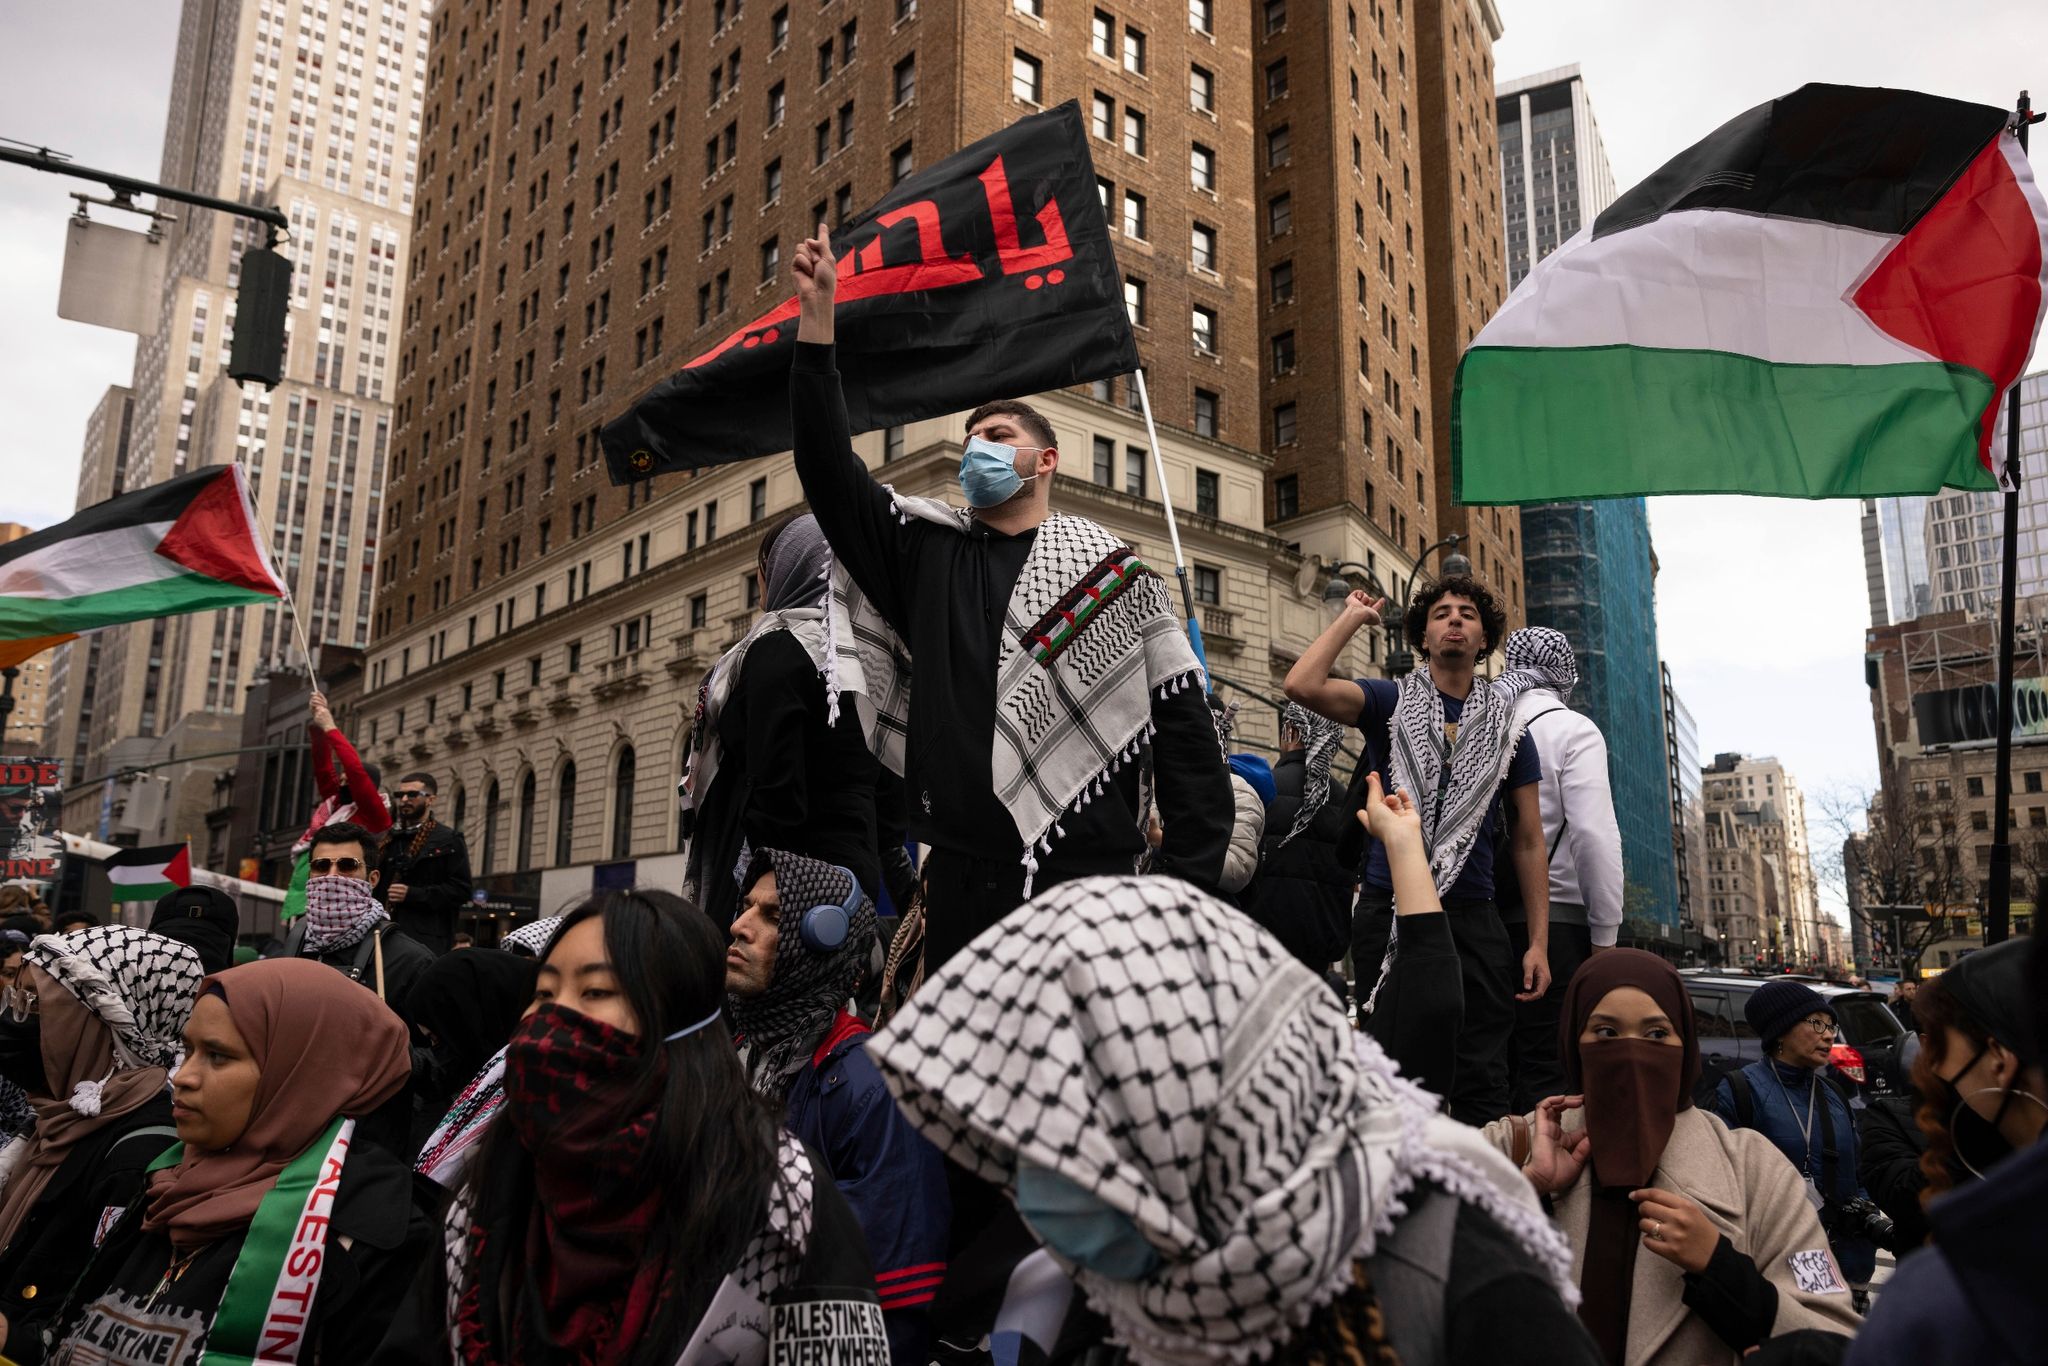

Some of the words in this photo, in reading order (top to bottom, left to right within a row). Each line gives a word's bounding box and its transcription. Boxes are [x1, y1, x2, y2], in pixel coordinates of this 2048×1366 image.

[978, 153, 1074, 291] يا
[257, 1138, 350, 1363] ALESTIN
[774, 1303, 869, 1340] PALESTINE
[869, 1304, 883, 1337] IS
[774, 1337, 891, 1366] EVERYWHERE
